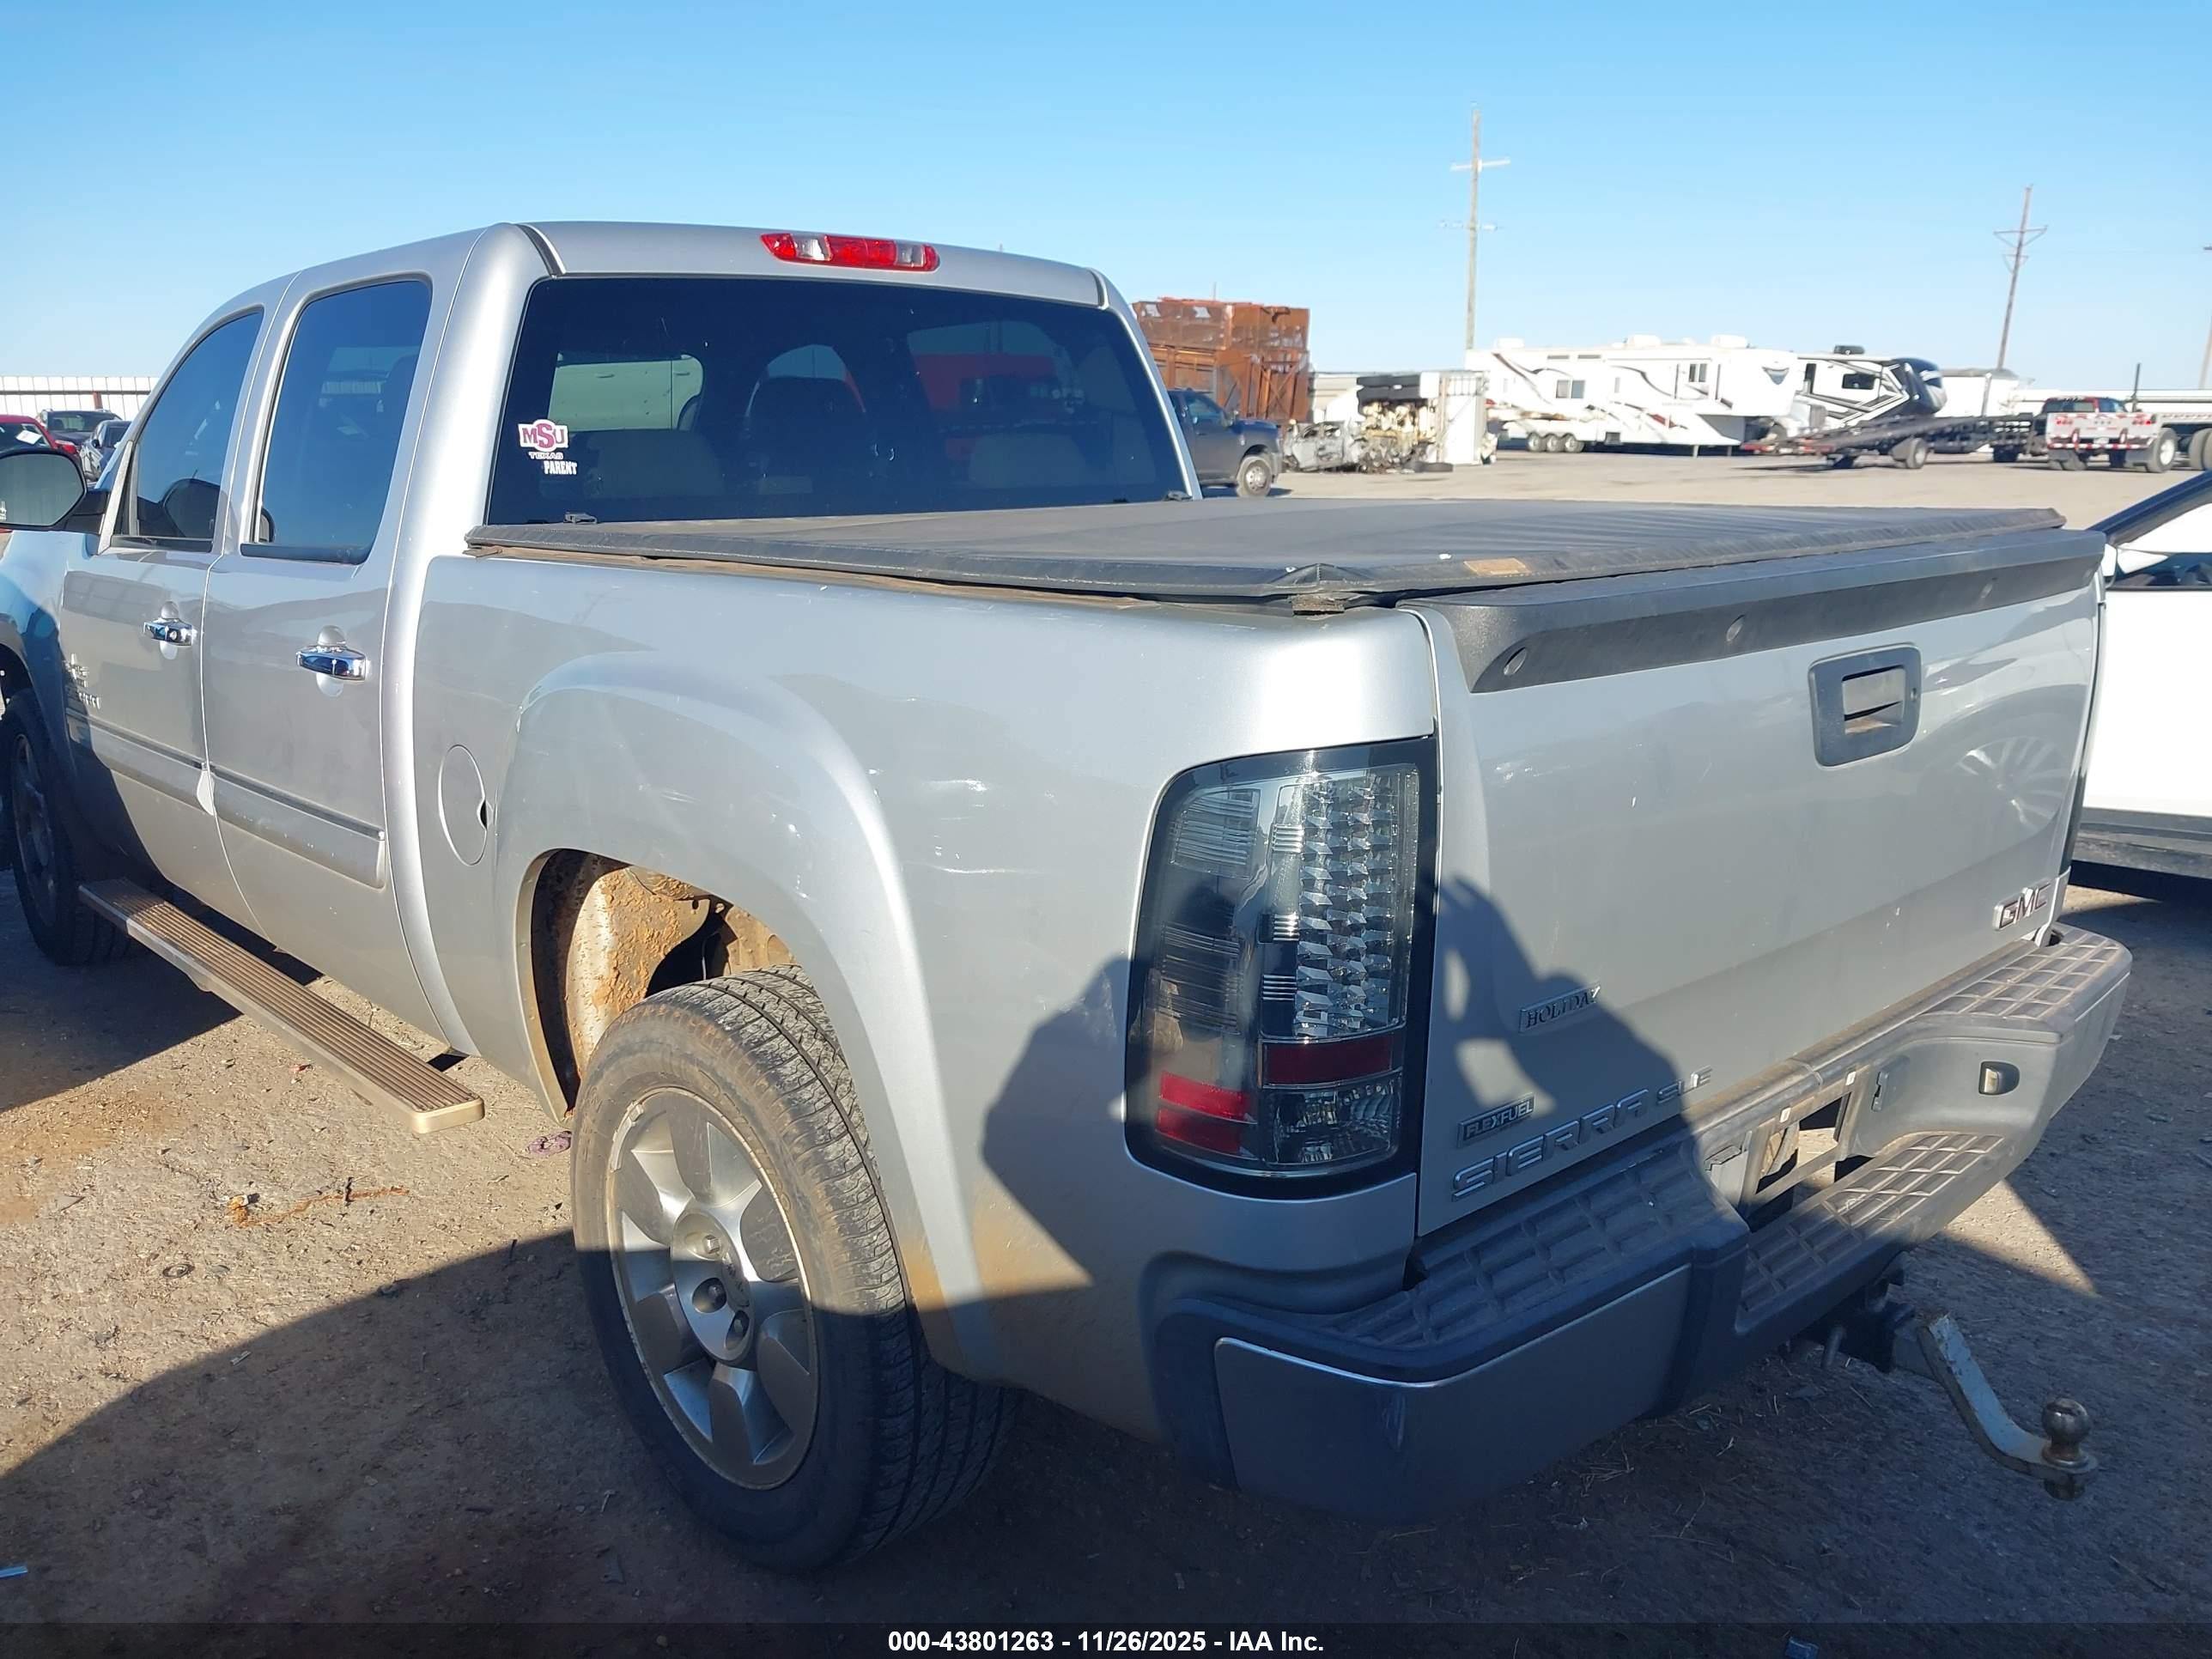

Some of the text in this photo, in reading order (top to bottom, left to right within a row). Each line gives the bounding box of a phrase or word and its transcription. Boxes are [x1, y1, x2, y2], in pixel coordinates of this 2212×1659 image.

[521, 422, 565, 448] MSU
[528, 452, 564, 460] TEXAS
[543, 460, 578, 475] PARENT
[1997, 882, 2051, 930] GMC
[1525, 985, 1601, 1029] HOLIDAY
[1451, 1065, 1713, 1203] SIERRA SLE
[1464, 1096, 1535, 1139] FLEXFUEL
